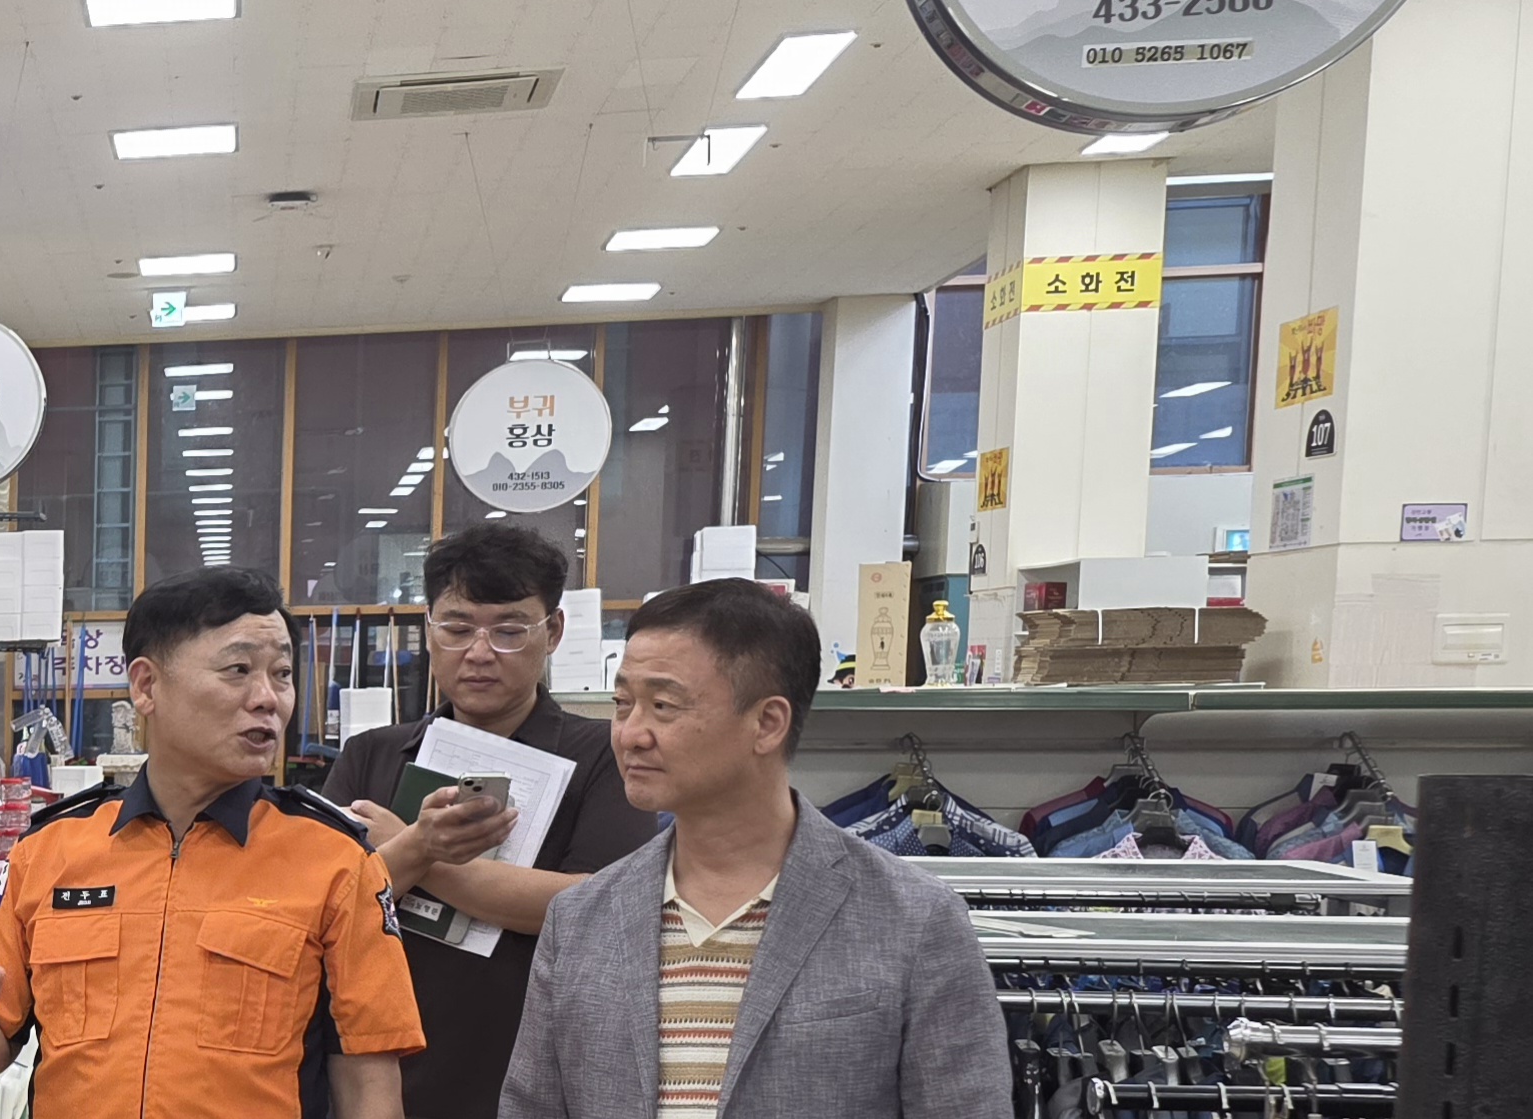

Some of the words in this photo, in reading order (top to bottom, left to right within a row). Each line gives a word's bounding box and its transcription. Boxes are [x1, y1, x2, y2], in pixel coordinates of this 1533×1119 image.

[1086, 47, 1123, 64] 010
[1134, 45, 1185, 63] 5265
[1196, 43, 1248, 61] 1067
[507, 395, 556, 419] 부귀
[506, 423, 556, 448] 홍삼
[1310, 422, 1331, 447] 107
[507, 471, 551, 481] 432-1513
